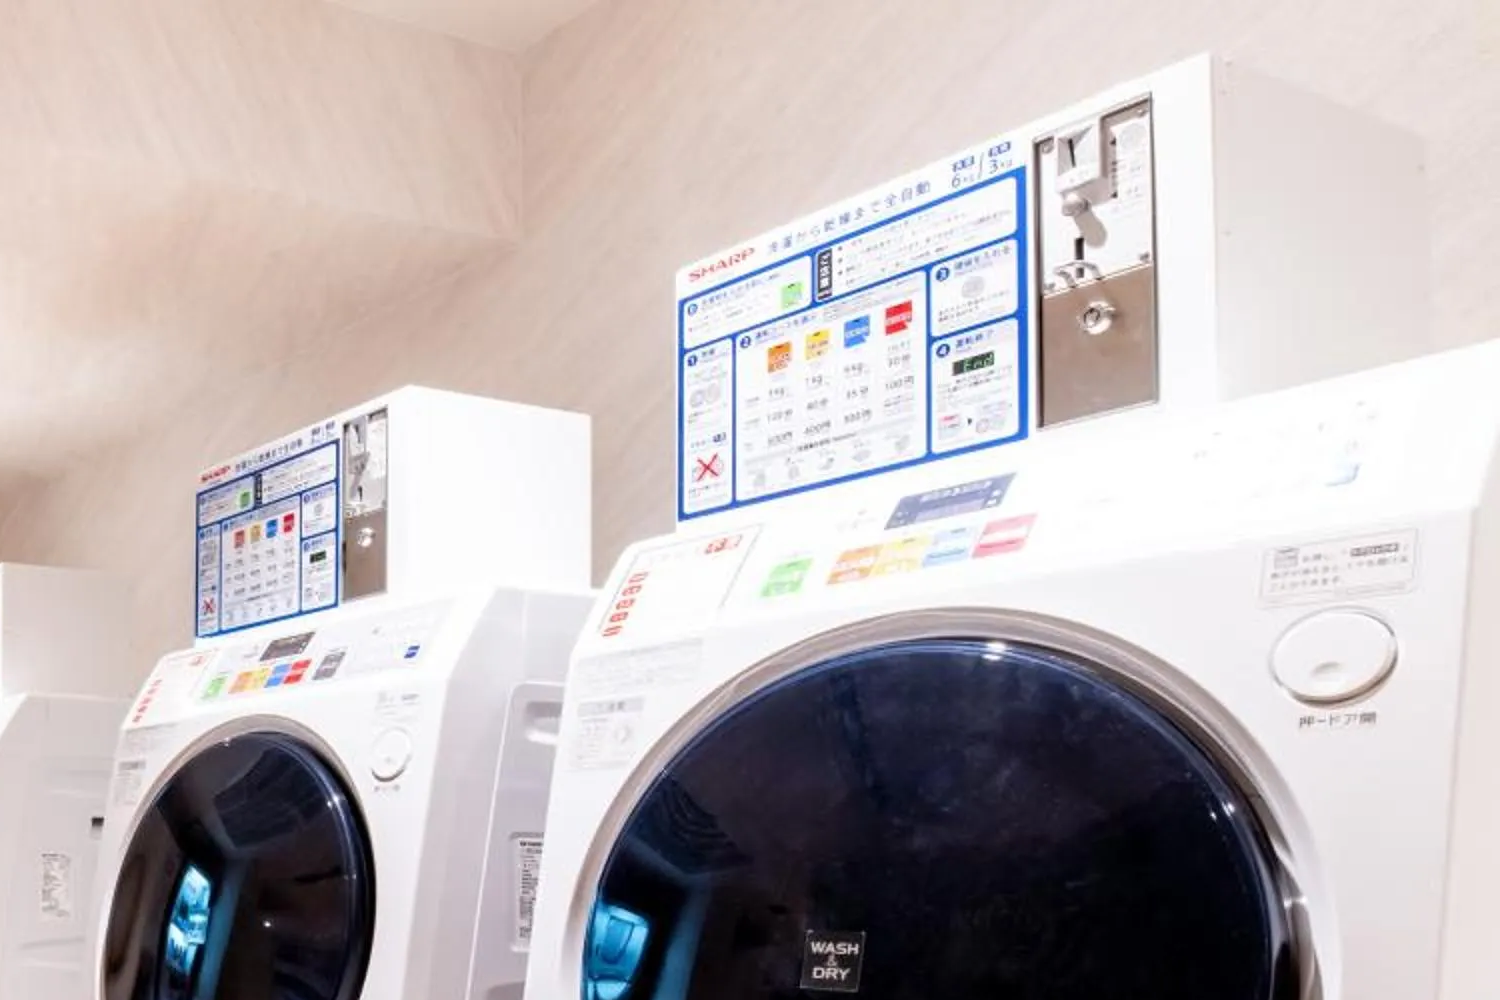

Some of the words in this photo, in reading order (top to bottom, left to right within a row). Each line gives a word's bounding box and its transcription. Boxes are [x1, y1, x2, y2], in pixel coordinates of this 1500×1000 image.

[688, 247, 755, 282] SHARP
[811, 941, 860, 955] WASH
[811, 966, 851, 981] DRY
